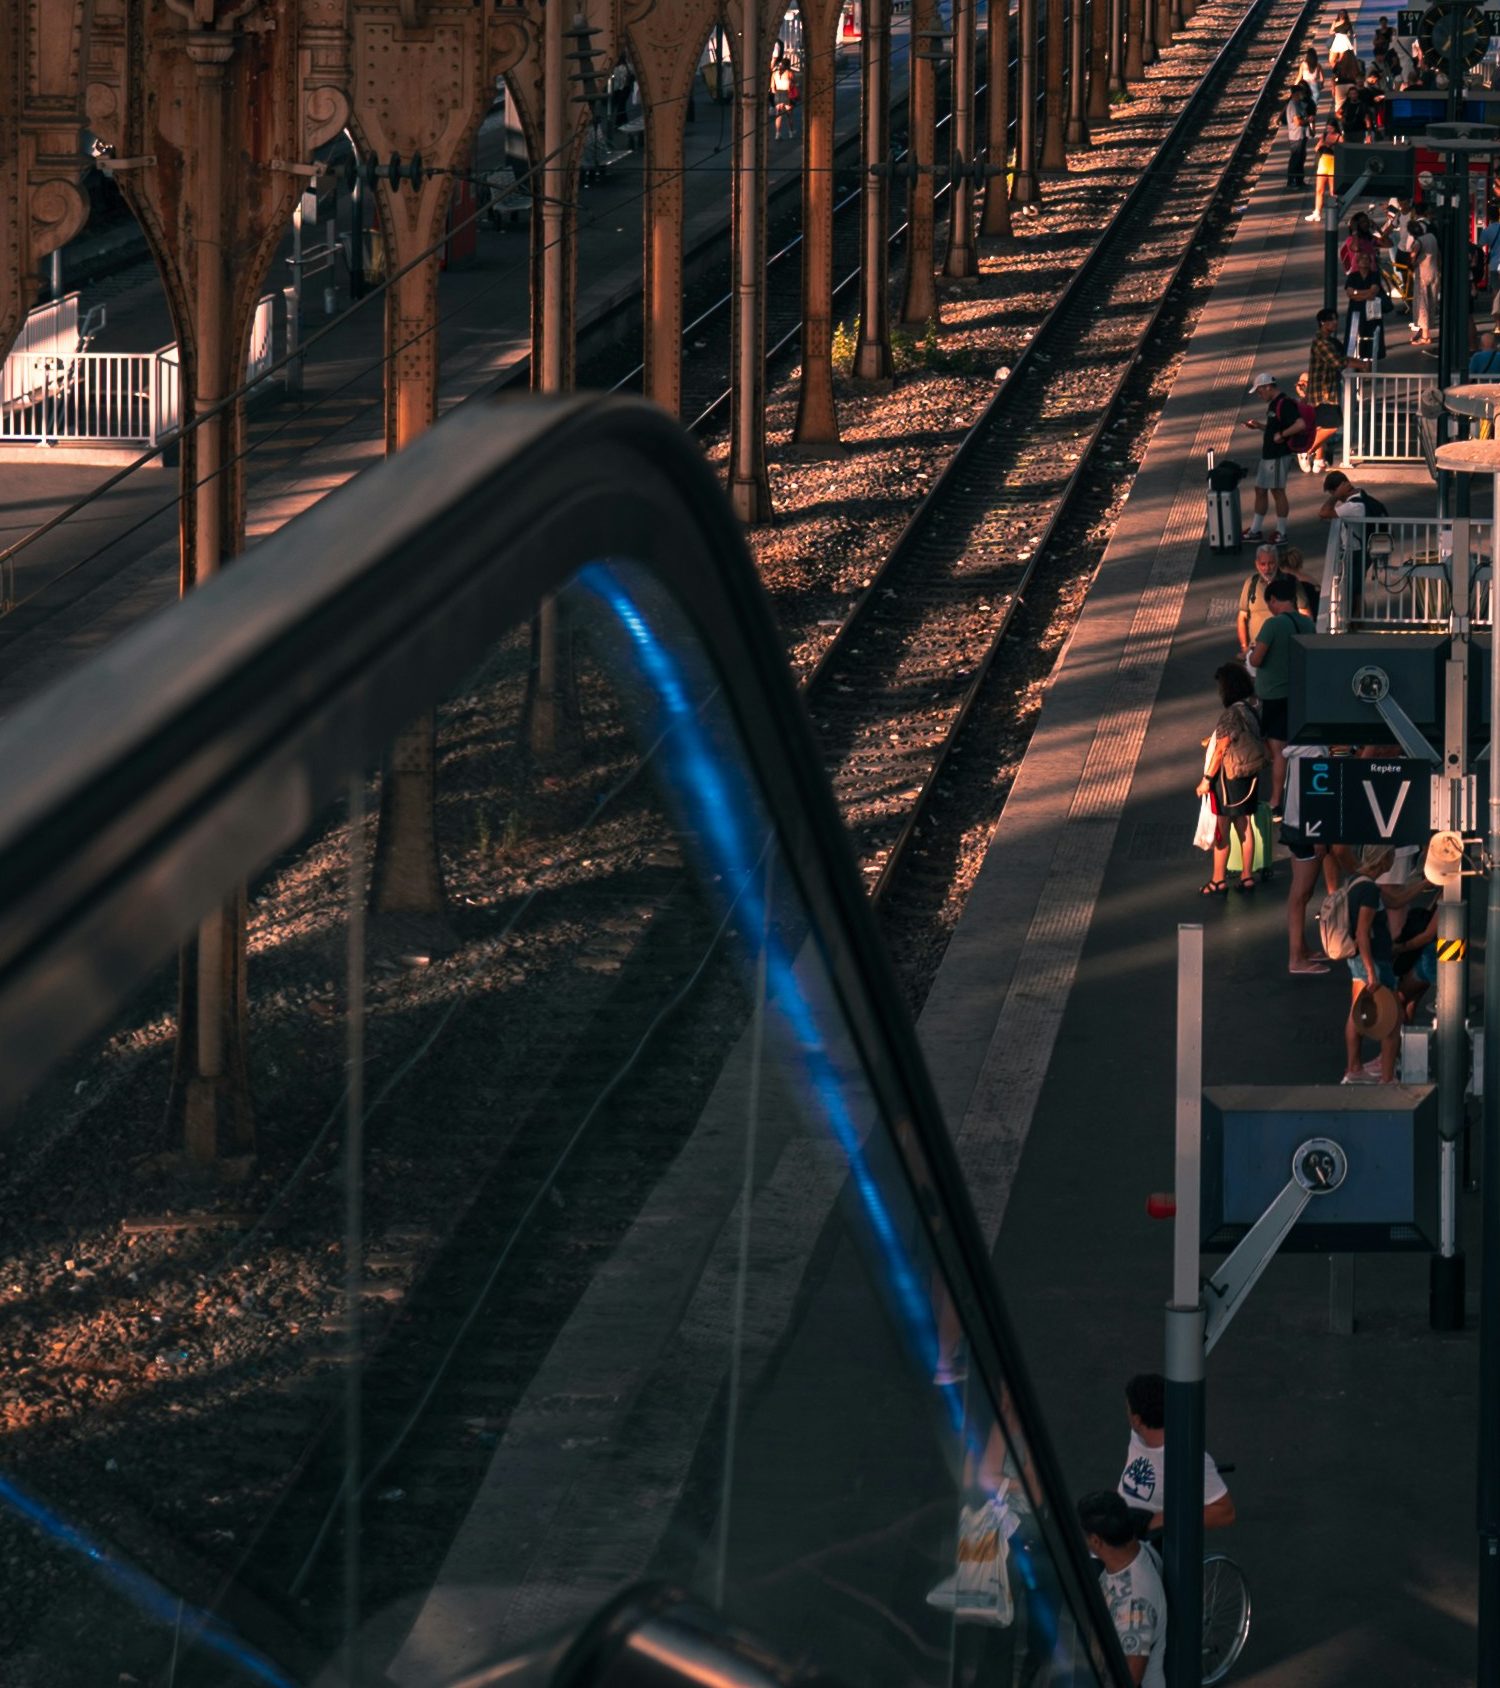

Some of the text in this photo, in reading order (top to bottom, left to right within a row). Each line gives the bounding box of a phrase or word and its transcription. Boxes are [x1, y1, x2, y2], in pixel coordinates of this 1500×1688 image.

[1403, 12, 1419, 21] TGV
[1370, 764, 1401, 774] Repère
[1312, 773, 1329, 792] C
[1362, 780, 1411, 838] V
